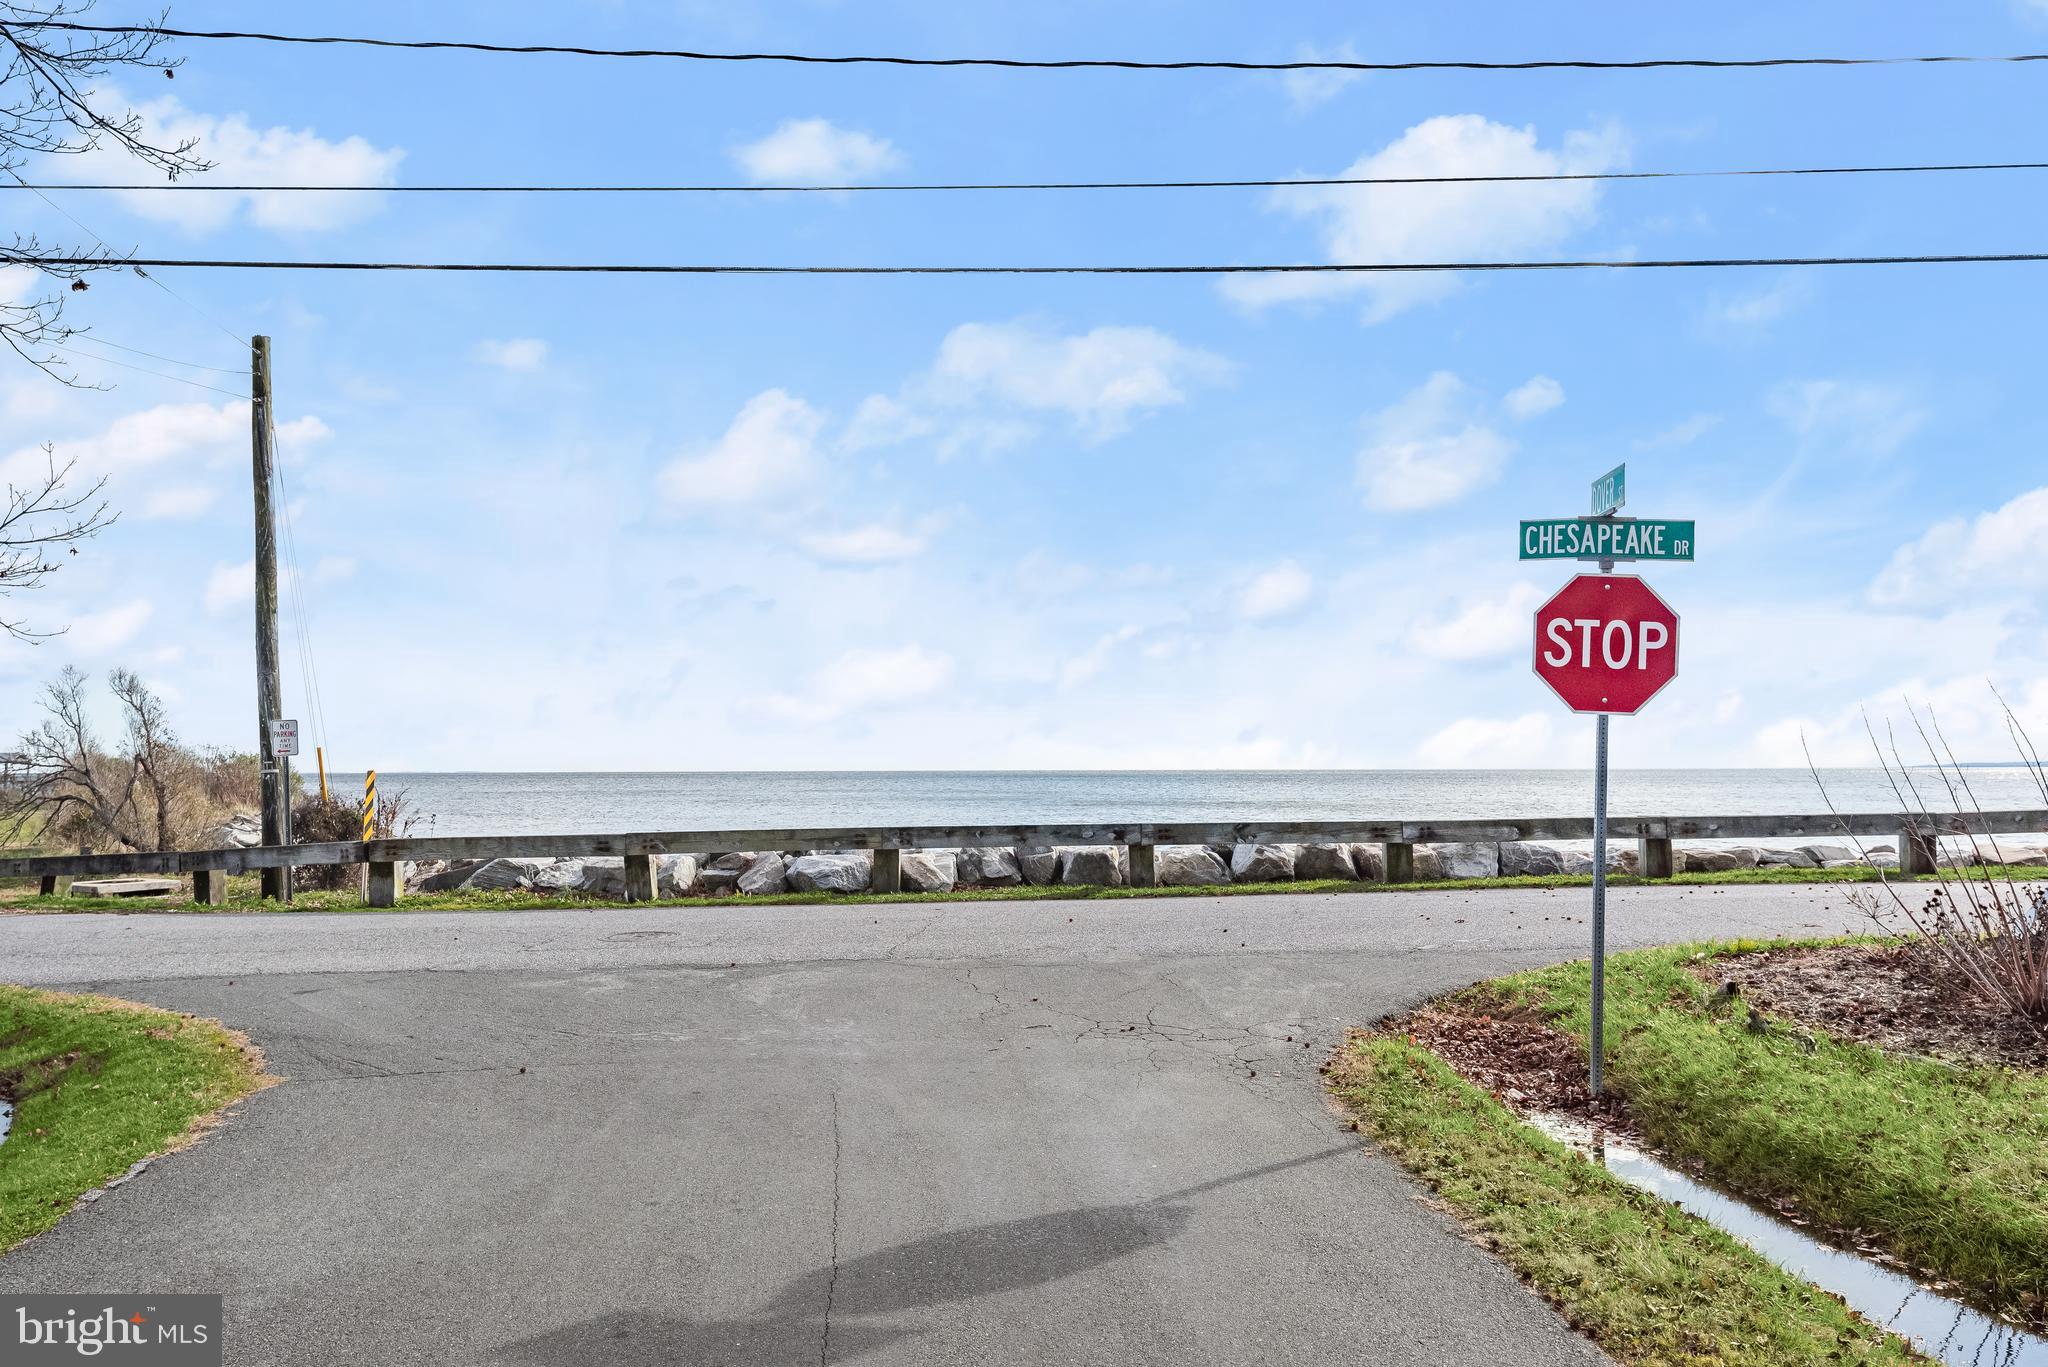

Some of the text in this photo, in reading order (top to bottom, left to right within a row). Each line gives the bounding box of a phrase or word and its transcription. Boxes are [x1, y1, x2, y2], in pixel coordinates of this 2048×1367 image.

[1593, 477, 1614, 514] DOVER
[1525, 524, 1689, 555] CHESAPEAKE DR
[1543, 617, 1669, 670] STOP
